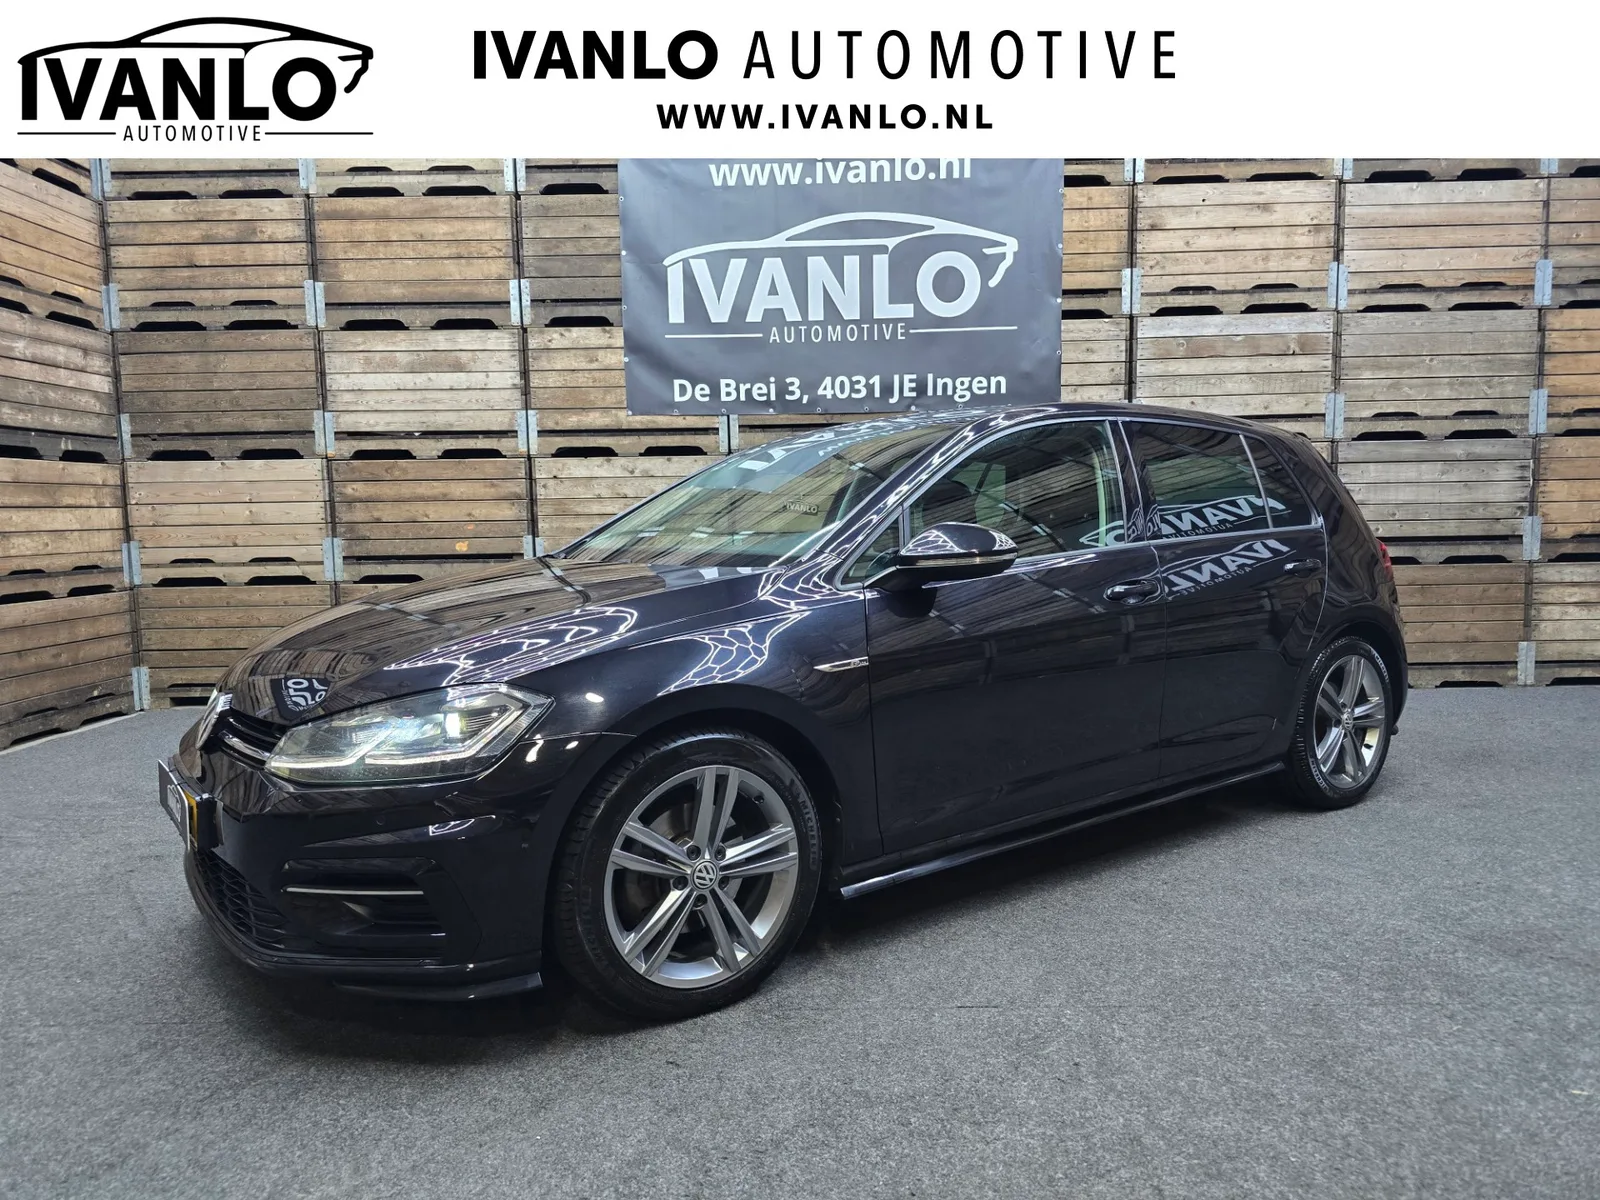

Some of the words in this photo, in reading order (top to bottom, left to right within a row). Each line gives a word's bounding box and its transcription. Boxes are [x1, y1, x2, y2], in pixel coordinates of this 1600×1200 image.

[666, 251, 982, 324] IVANLO
[769, 323, 906, 344] AUTOMOTIVE
[673, 379, 711, 403] De
[720, 377, 776, 402] Brei
[786, 377, 809, 404] 3,
[818, 375, 881, 400] 4031
[889, 373, 917, 404] JE
[928, 372, 1007, 403] Ingen
[786, 503, 818, 514] IVANLO
